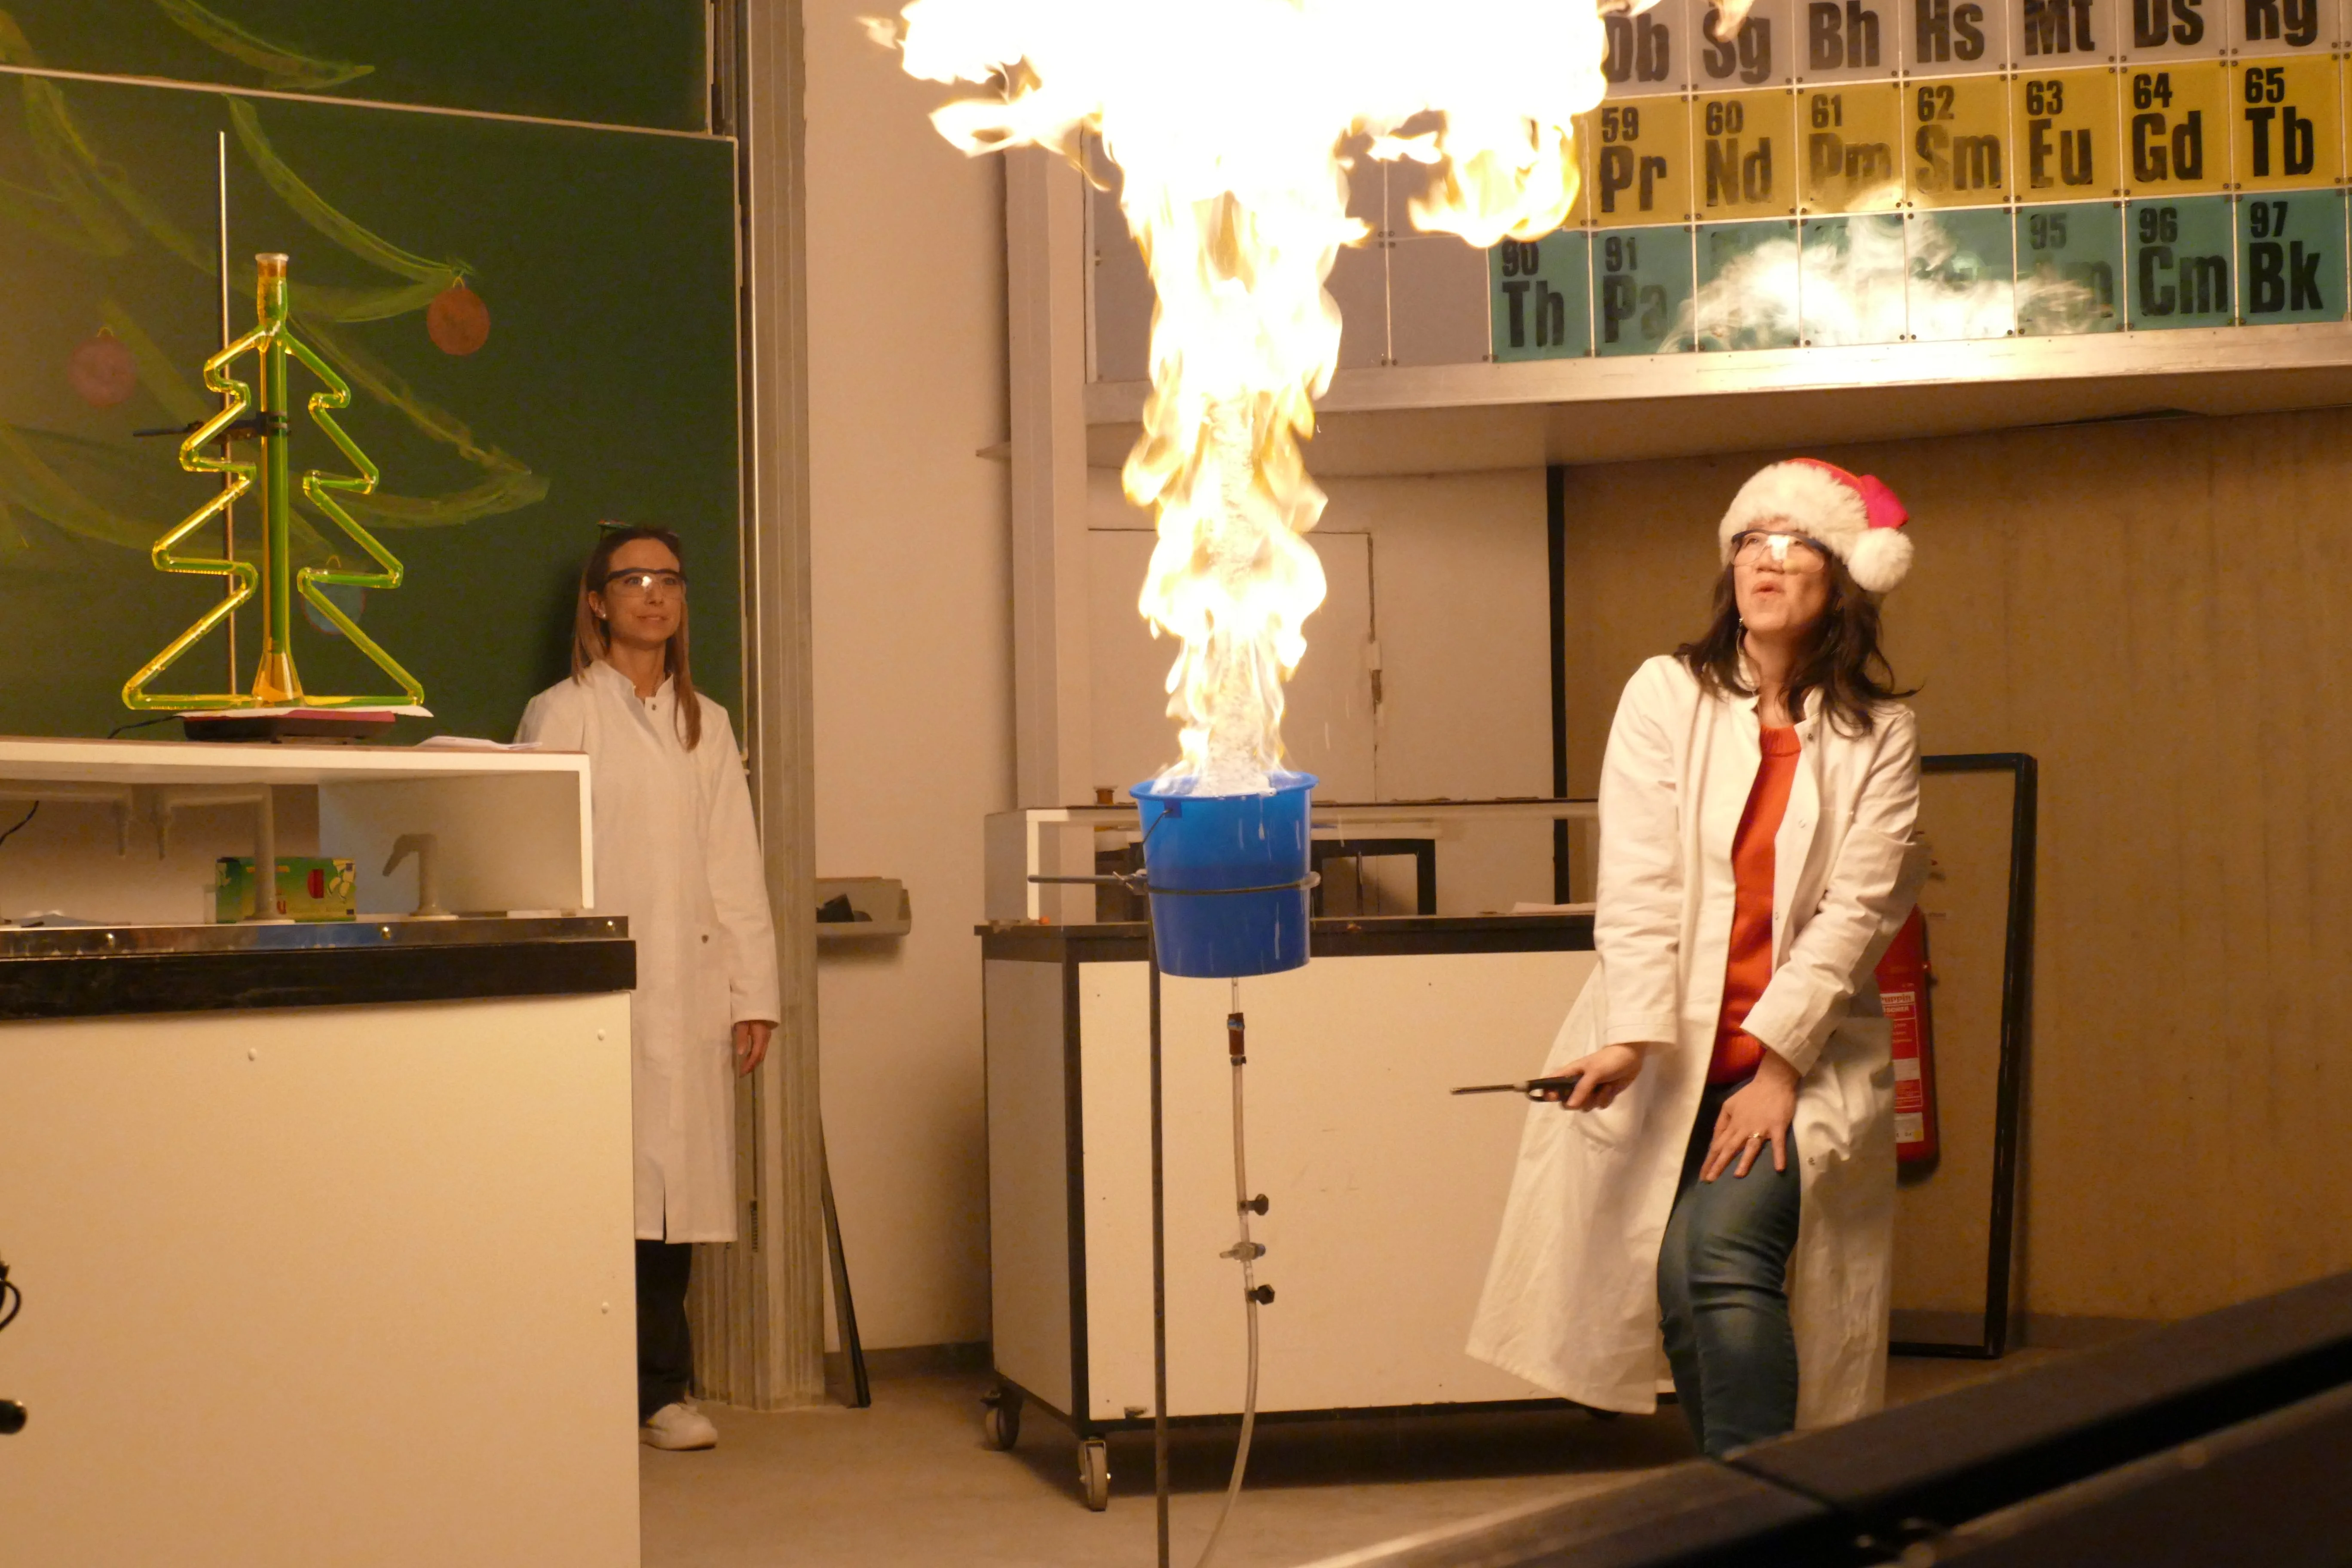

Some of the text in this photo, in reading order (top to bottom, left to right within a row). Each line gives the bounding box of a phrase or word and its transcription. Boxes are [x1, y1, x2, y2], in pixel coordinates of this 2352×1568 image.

[1603, 13, 1669, 82] Db
[1703, 9, 1770, 84] Sg
[1810, 1, 1880, 70] Bh
[1915, 0, 1984, 63] Hs
[2024, 0, 2095, 55] Mt
[2134, 0, 2205, 48] Ds
[2245, 0, 2318, 46] Rg
[1812, 94, 1842, 128] 61
[1918, 86, 1955, 122] 62
[2026, 81, 2064, 116] 63
[2133, 73, 2172, 108] 64
[2245, 67, 2285, 104] 65
[1602, 107, 1638, 142] 59
[1706, 100, 1743, 136] 60
[2245, 106, 2315, 177] Tb
[1706, 137, 1771, 207] Nd
[1915, 125, 2001, 194] Sm
[2029, 119, 2092, 188] Eu
[2132, 110, 2203, 182] Gd
[1600, 145, 1667, 212] Pr
[2030, 213, 2067, 250] 95
[2139, 208, 2178, 244] 96
[2250, 202, 2288, 239] 97
[1501, 241, 1539, 276] 90
[1605, 236, 1637, 272] 91
[2138, 246, 2229, 317] Cm
[2249, 241, 2323, 314] Bk
[1502, 281, 1564, 347] Th
[1603, 275, 1667, 343] Pa
